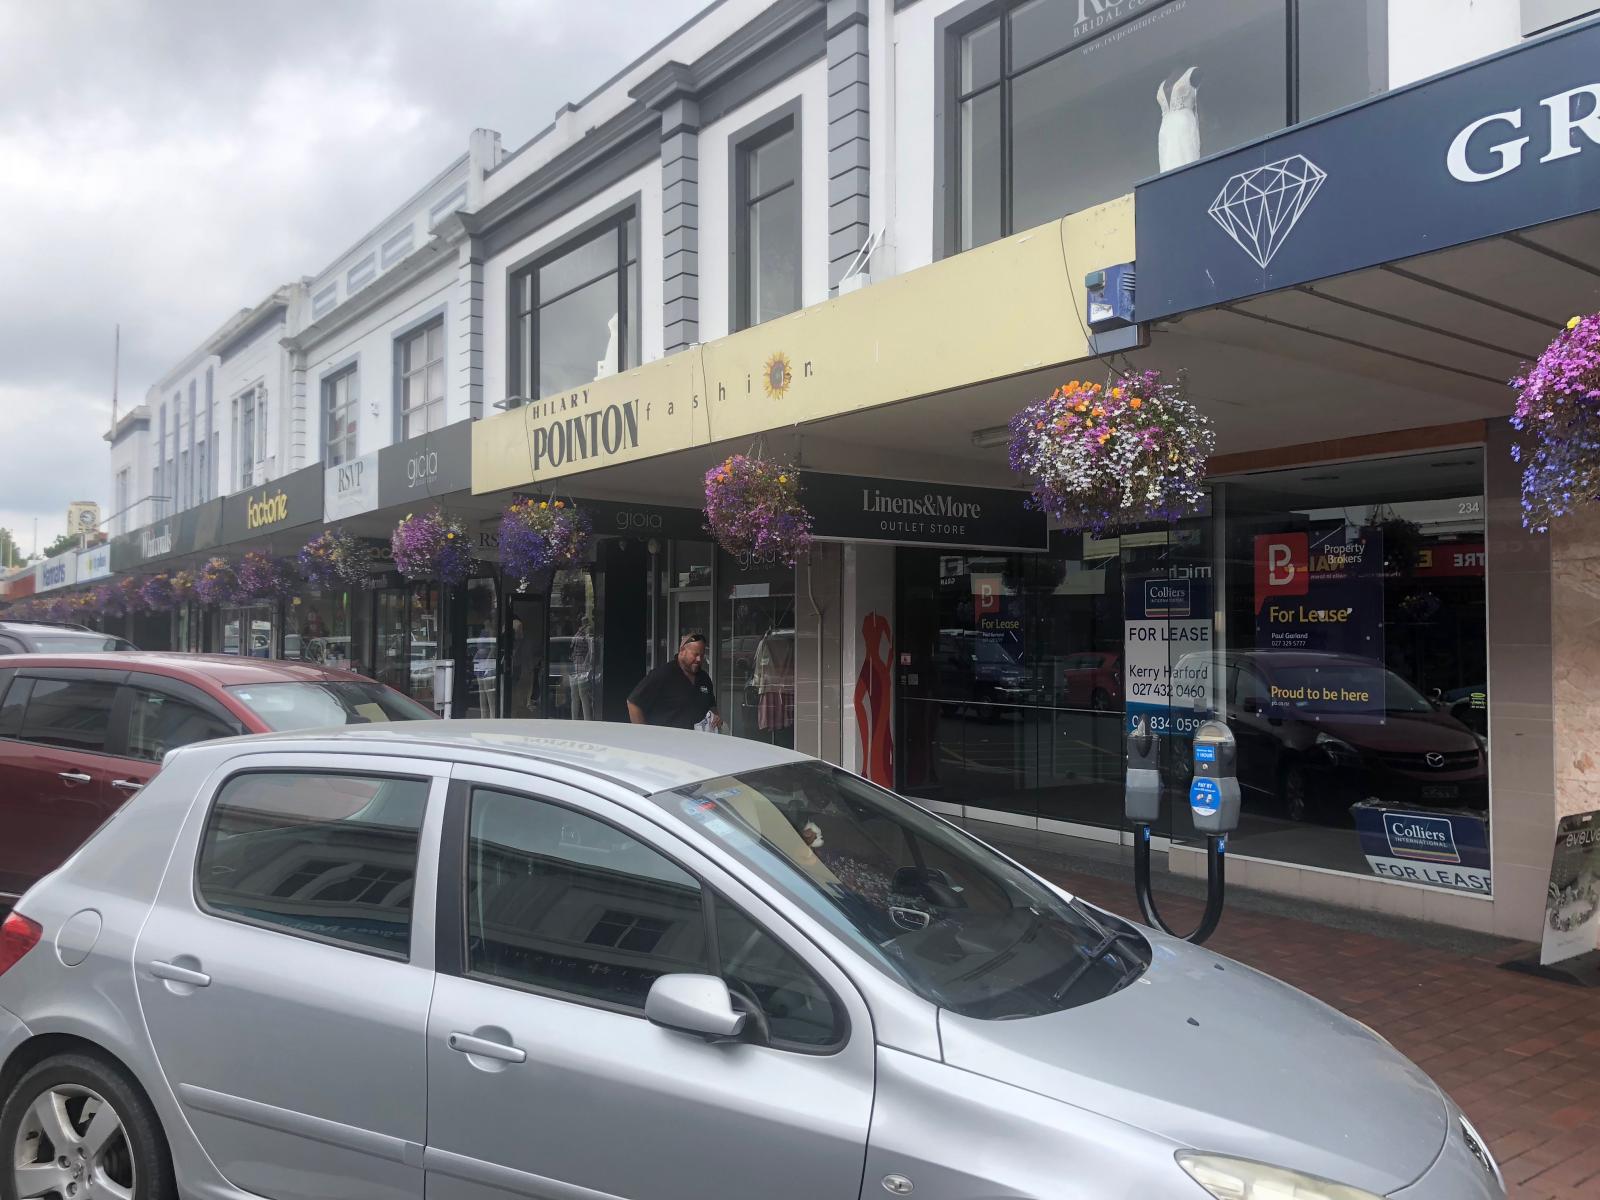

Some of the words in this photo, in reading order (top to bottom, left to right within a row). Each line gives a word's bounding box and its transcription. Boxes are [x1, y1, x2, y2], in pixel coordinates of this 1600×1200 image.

[1073, 9, 1122, 39] BRIDAL
[1447, 83, 1600, 182] GR
[532, 389, 590, 420] HILARY
[533, 399, 639, 471] POINTON
[338, 461, 364, 493] RSVP
[863, 489, 981, 519] Linens&More
[1458, 502, 1480, 514] 234
[880, 521, 924, 533] OUTLET
[930, 523, 966, 535] STORE
[1324, 543, 1365, 556] Property
[1327, 553, 1362, 565] Brokers
[1150, 586, 1185, 598] Colliers
[1269, 606, 1295, 623] For
[1299, 606, 1348, 623] Lease
[982, 618, 994, 629] For
[996, 618, 1020, 629] Lease
[1129, 627, 1156, 641] FOR
[1161, 627, 1209, 641] LEASE
[1129, 664, 1160, 681] Kerry
[1164, 666, 1208, 680] Harford
[1176, 684, 1205, 698] 0460
[1271, 685, 1304, 699] Proud
[1307, 688, 1320, 700] to
[1323, 688, 1337, 701] be
[1341, 688, 1368, 702] here
[1392, 821, 1446, 842] Colliers
[1394, 836, 1448, 848] INTERNATIONAL
[1375, 862, 1418, 880] FOR
